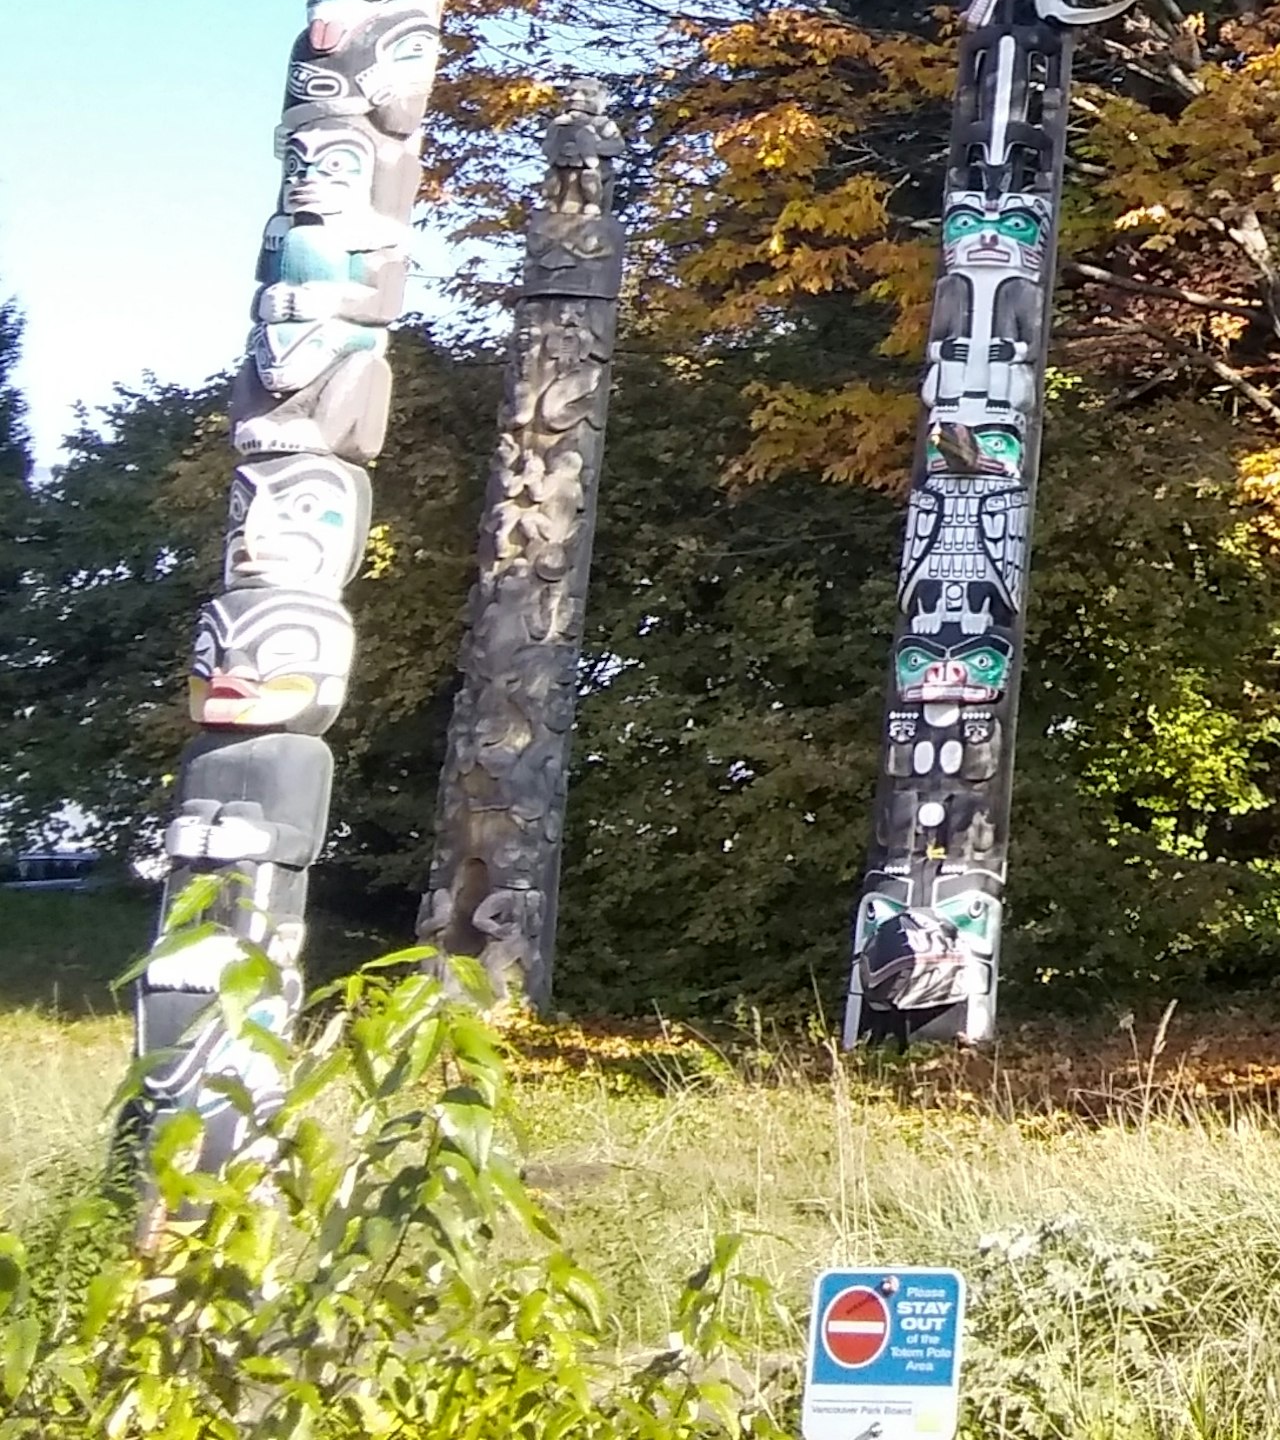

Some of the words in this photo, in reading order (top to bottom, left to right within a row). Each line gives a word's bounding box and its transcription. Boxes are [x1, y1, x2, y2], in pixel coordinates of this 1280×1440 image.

[906, 1287, 946, 1298] Please
[897, 1301, 952, 1315] STAY
[901, 1317, 947, 1331] OUT
[906, 1334, 919, 1344] of
[921, 1334, 940, 1344] the
[891, 1346, 924, 1358] Totem
[926, 1347, 952, 1358] Pole
[905, 1361, 934, 1371] Area
[811, 1405, 858, 1414] Vancouver
[860, 1406, 881, 1414] Park
[884, 1406, 912, 1415] Board
